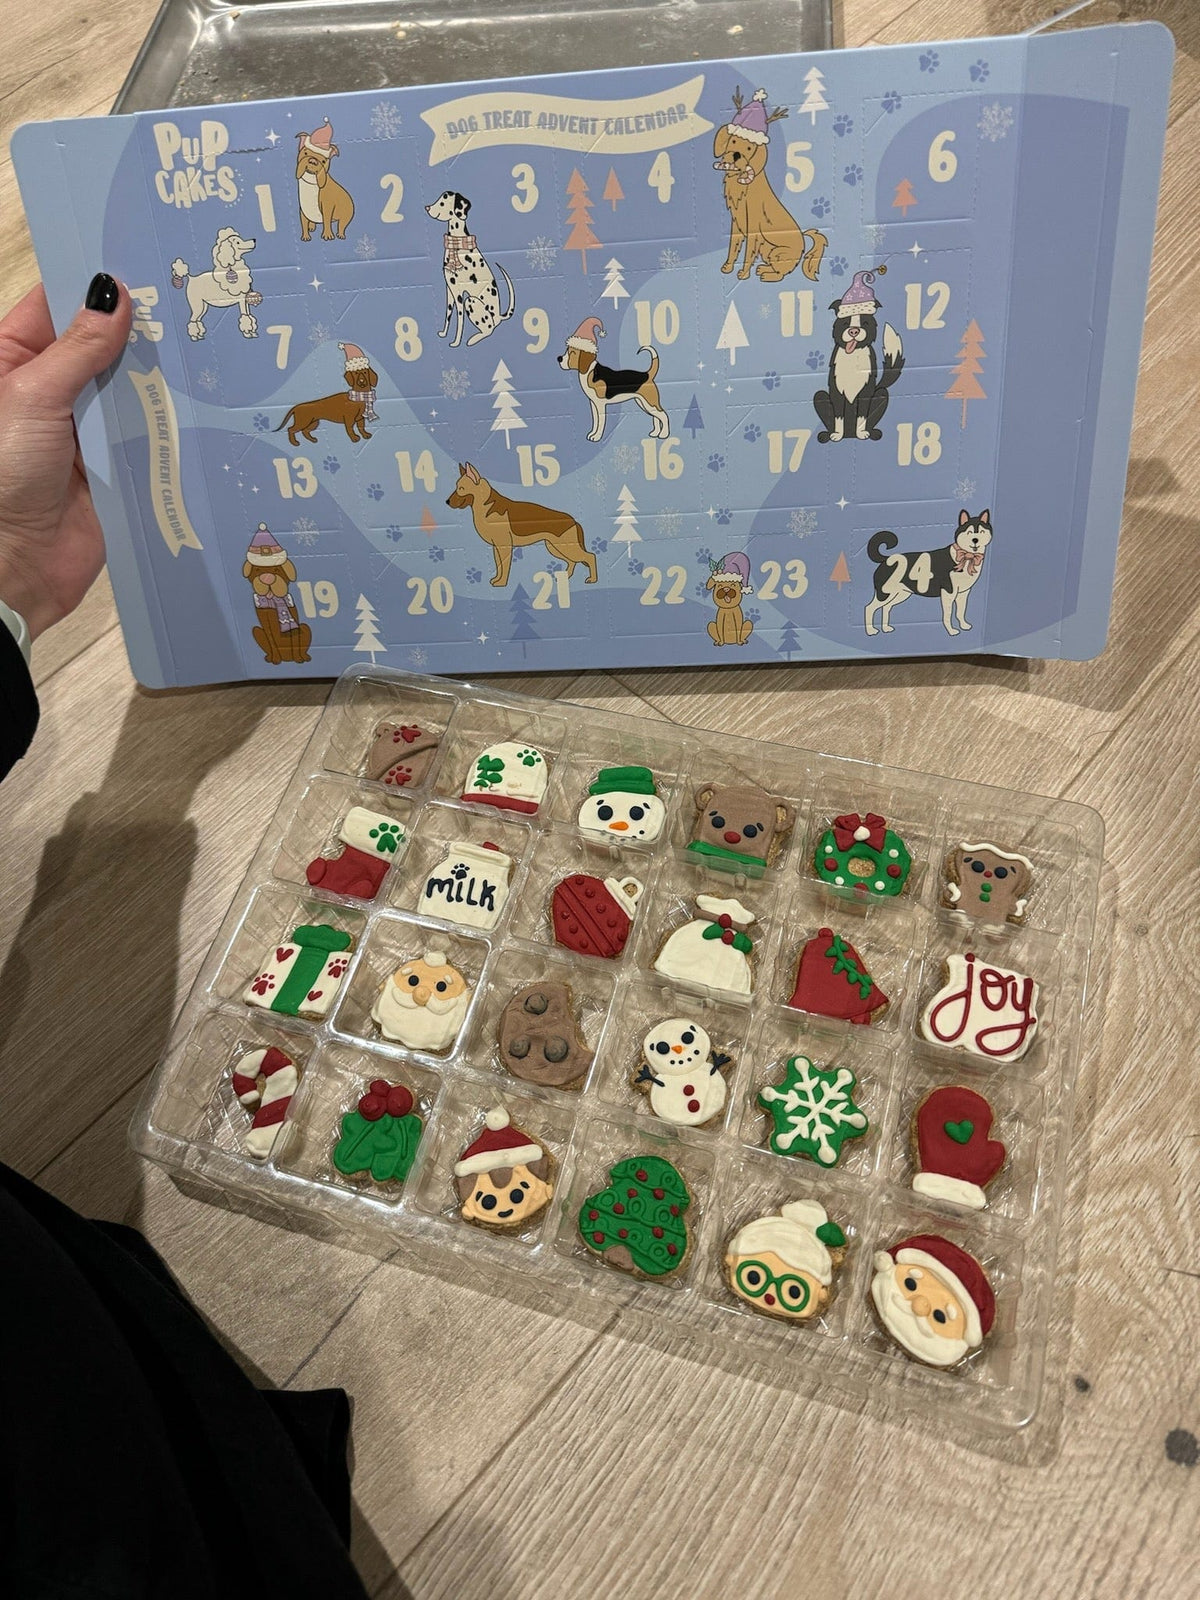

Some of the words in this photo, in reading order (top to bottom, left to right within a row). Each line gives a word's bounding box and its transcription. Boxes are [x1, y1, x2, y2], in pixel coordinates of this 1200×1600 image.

[446, 113, 479, 140] DOG
[482, 109, 533, 131] TREAT
[537, 111, 598, 136] ADVENT
[603, 103, 689, 137] CALENDAR
[647, 151, 675, 203] 4
[785, 141, 815, 193] 5
[928, 130, 958, 183] 6
[255, 184, 277, 232] 1
[379, 174, 404, 223] 2
[511, 163, 539, 213] 3
[634, 299, 680, 346] 10
[778, 290, 814, 337] 11
[904, 281, 951, 330] 12
[266, 325, 292, 369] 7
[394, 317, 423, 362] 8
[522, 307, 550, 353] 9
[145, 384, 161, 406] DOG
[154, 408, 169, 443] TREAT
[897, 421, 942, 466] 18
[159, 446, 171, 485] ADVENT
[395, 450, 438, 492] 14
[516, 444, 560, 487] 15
[641, 436, 684, 480] 16
[767, 429, 811, 473] 17
[273, 457, 318, 498] 13
[161, 488, 187, 542] CALENDAR
[532, 570, 571, 610] 21
[640, 566, 687, 605] 22
[757, 559, 808, 600] 23
[881, 552, 934, 594] 24
[297, 580, 339, 618] 19
[407, 576, 454, 615] 20
